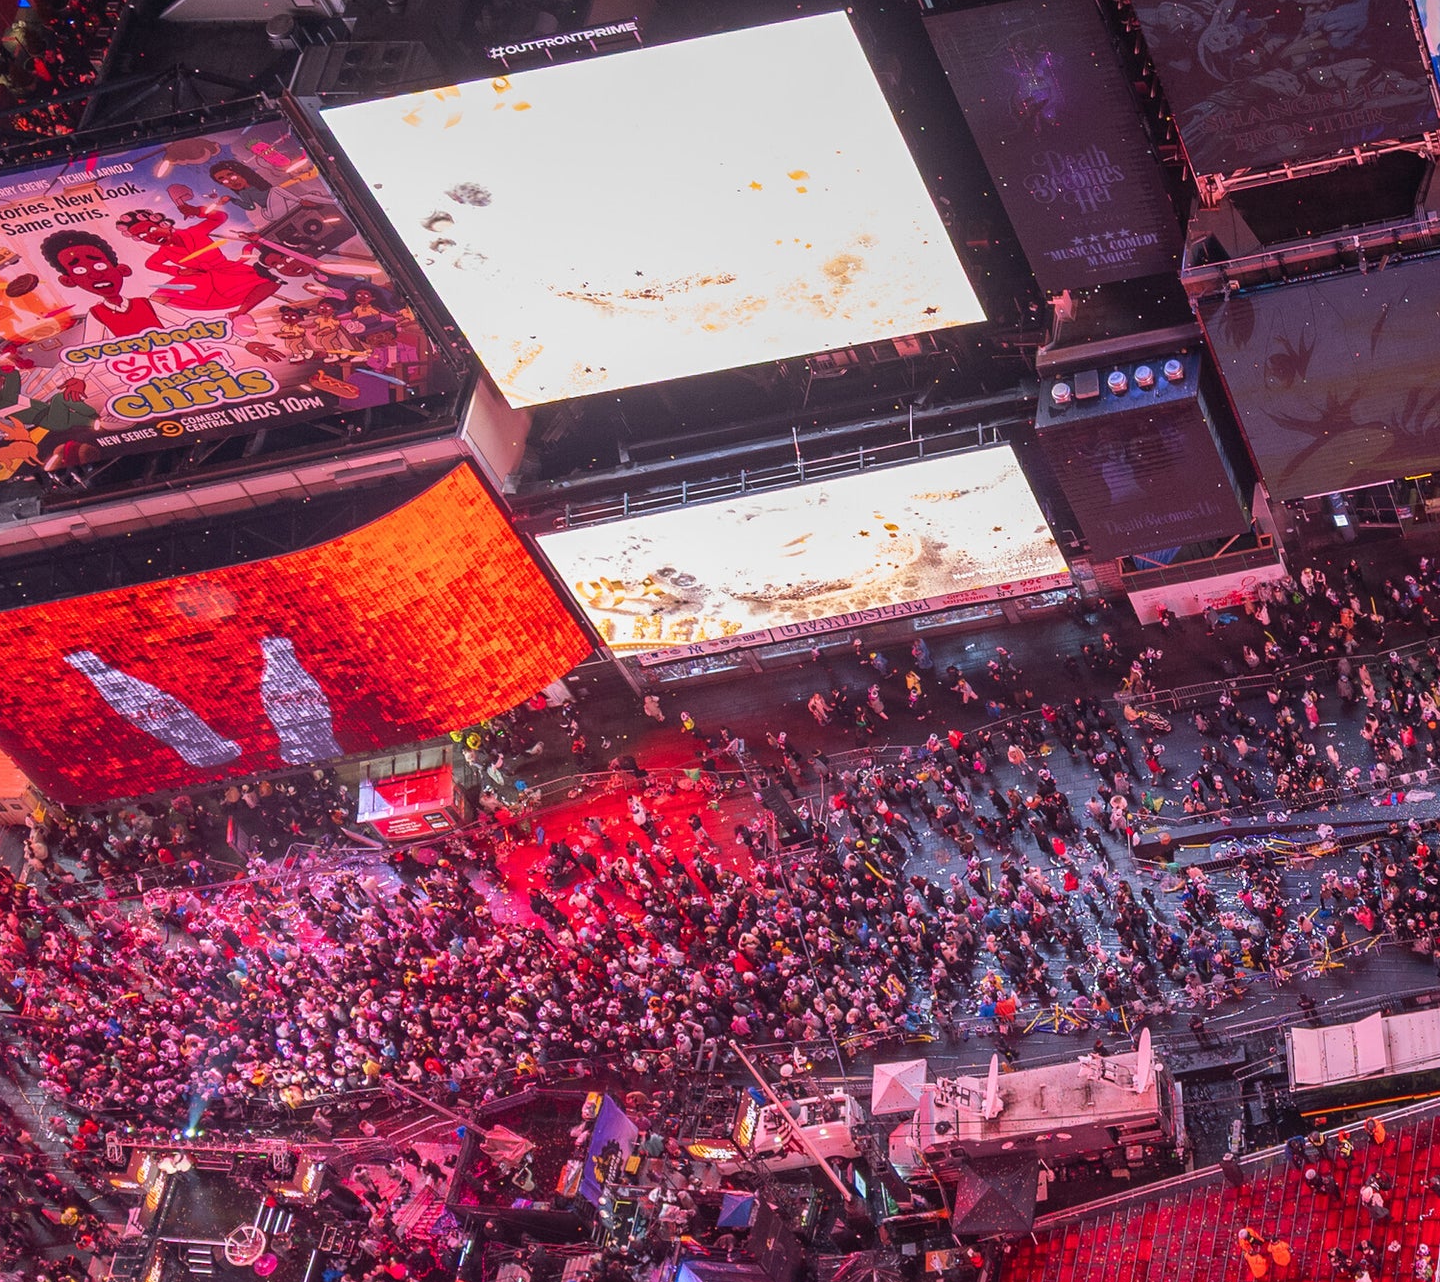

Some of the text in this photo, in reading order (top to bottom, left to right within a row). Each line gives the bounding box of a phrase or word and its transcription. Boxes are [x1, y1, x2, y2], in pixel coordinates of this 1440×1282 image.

[489, 22, 638, 59] #OUTFRONTPRIME
[57, 162, 134, 186] TICHINA ARNOLD
[1032, 145, 1110, 176] Death
[18, 179, 50, 193] CREWS
[57, 193, 94, 209] New
[101, 179, 146, 201] Look.
[1023, 165, 1126, 205] Becomes
[1064, 185, 1113, 215] Her
[1, 206, 110, 237] Same Chris.
[1110, 232, 1160, 251] COMEDY
[66, 319, 228, 364] everybody
[151, 360, 222, 390] hates
[112, 370, 275, 419] chris
[181, 396, 325, 426] COMEDY WEDS 10PM
[185, 418, 234, 433] CENTRAL
[97, 427, 158, 448] NEW SERIES
[1106, 517, 1144, 537] Death
[1143, 510, 1197, 529] Becomes
[942, 594, 989, 606] SOUVENIRS
[946, 592, 968, 601] GIFTS
[998, 588, 1016, 598] NY
[1023, 586, 1044, 594] Dept.
[780, 597, 932, 639] GRANDSLAM
